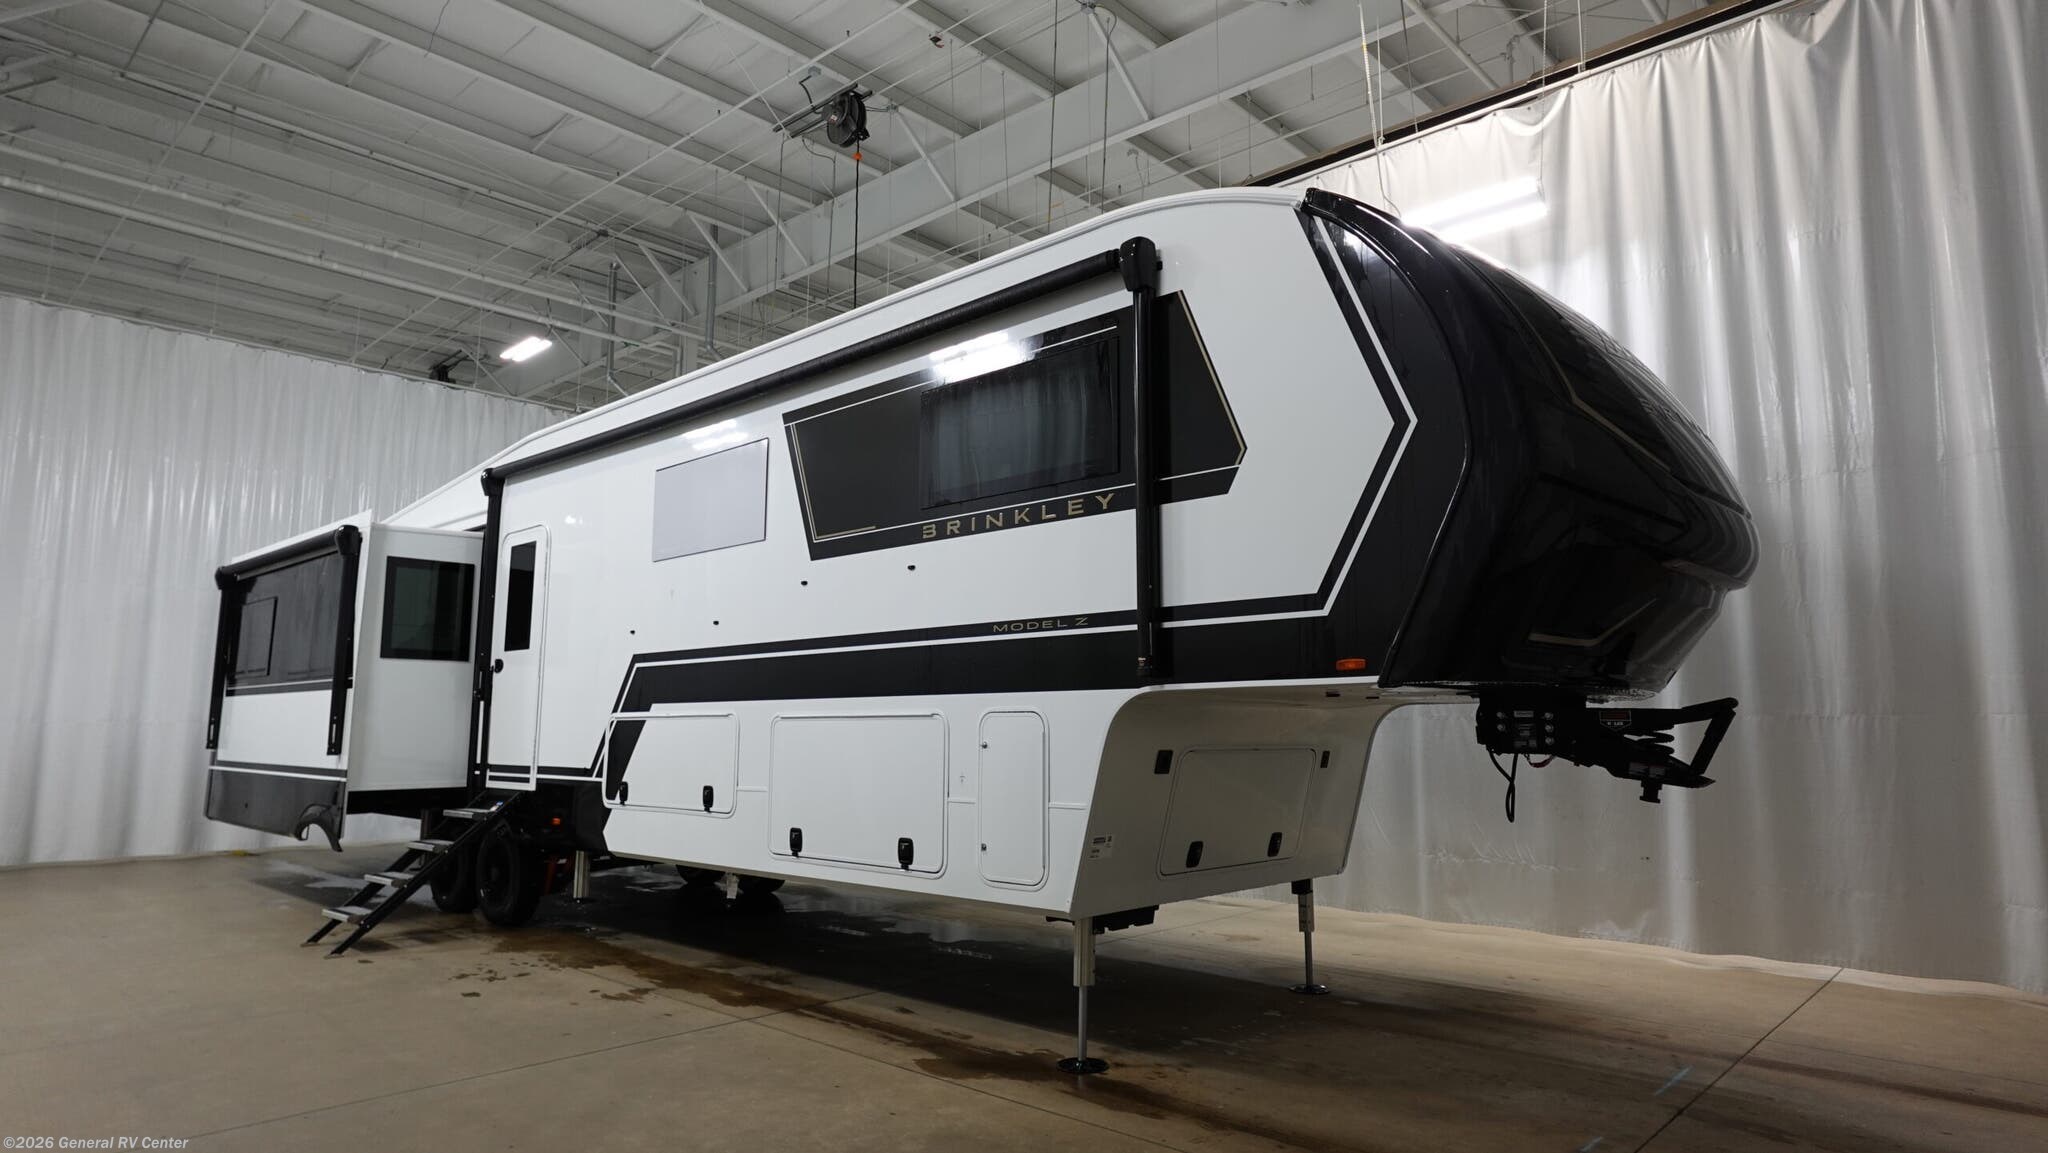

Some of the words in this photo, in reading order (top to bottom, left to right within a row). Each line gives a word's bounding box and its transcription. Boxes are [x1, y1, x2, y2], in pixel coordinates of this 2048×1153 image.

[922, 493, 1115, 539] BRINKLEY
[992, 618, 1068, 633] MODEL
[1074, 617, 1089, 626] Z
